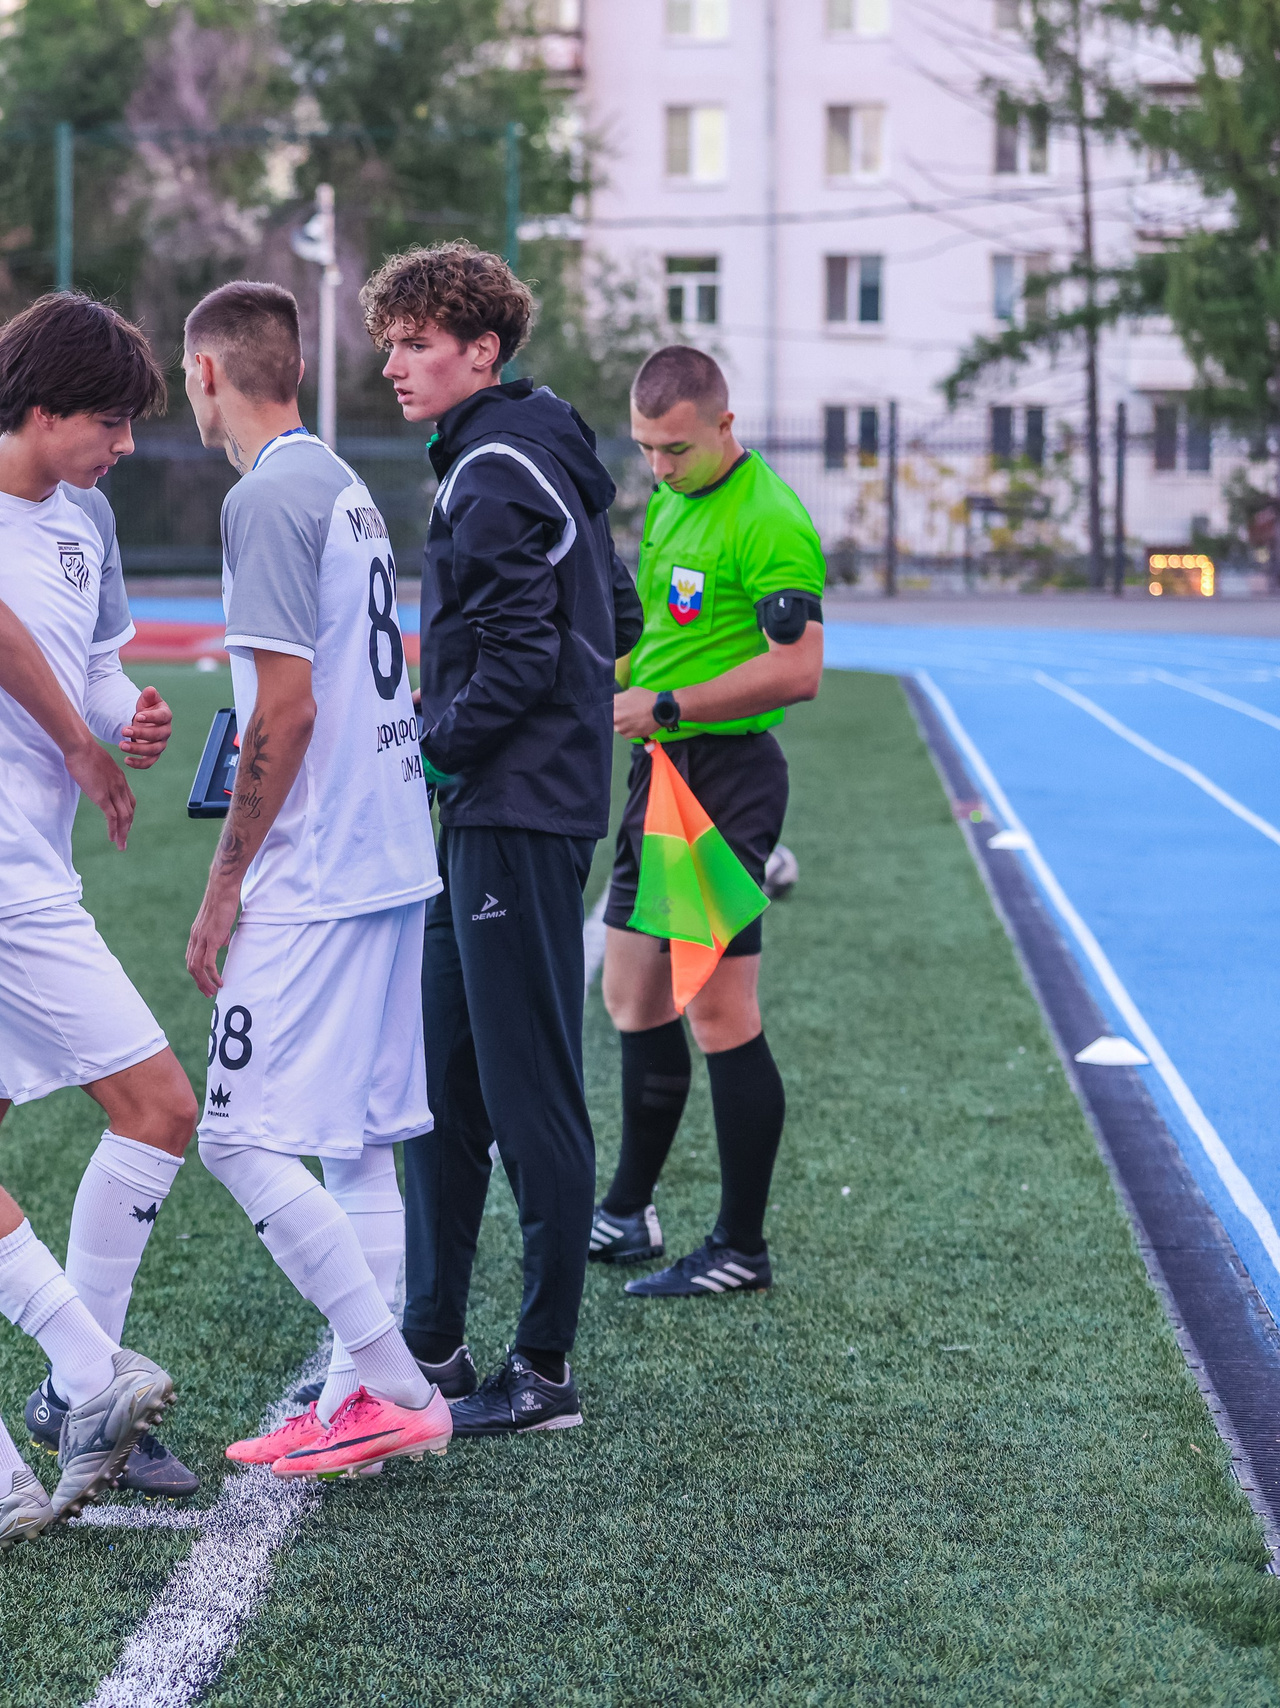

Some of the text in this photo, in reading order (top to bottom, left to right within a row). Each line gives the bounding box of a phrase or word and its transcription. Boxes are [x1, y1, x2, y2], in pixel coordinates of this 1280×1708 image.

[471, 908, 507, 921] DEMIX
[207, 1110, 230, 1118] PRIMERA
[521, 1403, 542, 1412] KELME
